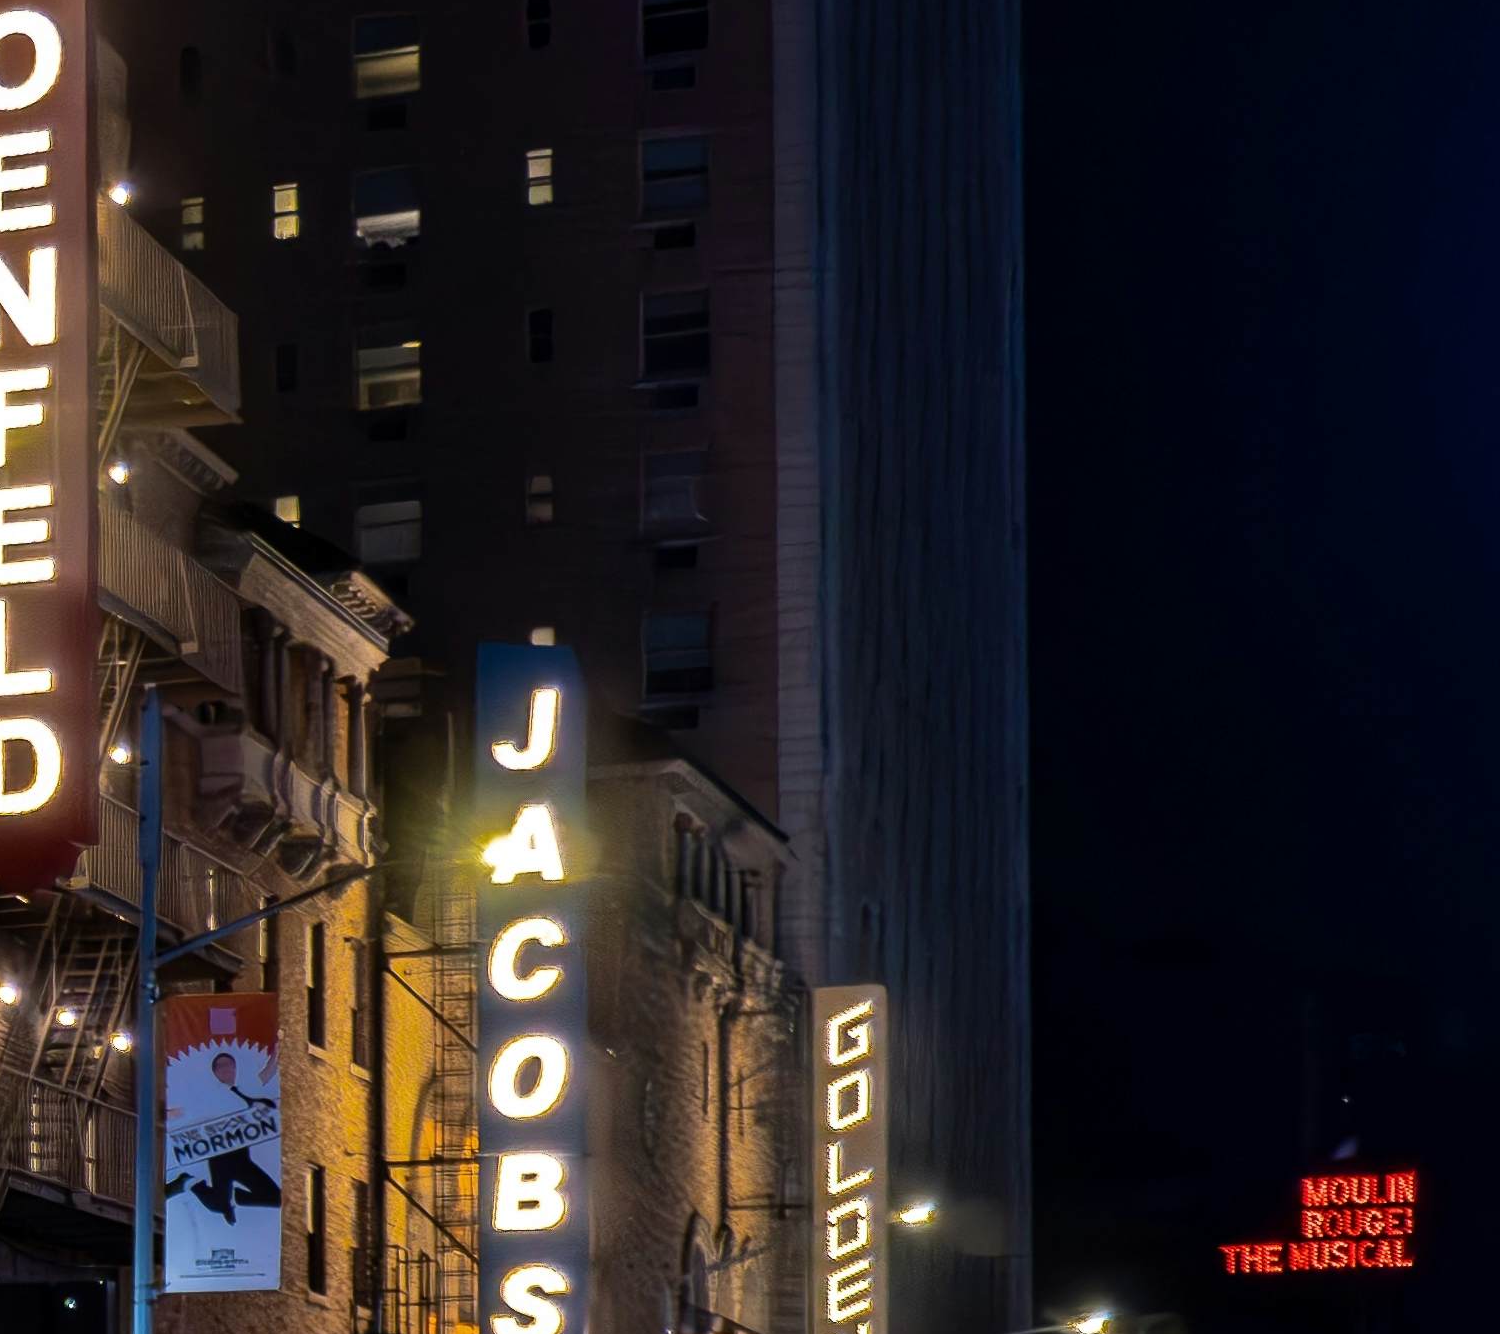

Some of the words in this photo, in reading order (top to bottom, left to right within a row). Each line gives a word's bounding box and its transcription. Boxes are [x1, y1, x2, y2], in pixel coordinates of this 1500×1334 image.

[173, 1116, 278, 1164] MORMON
[1301, 1170, 1414, 1207] MOULIN
[1217, 1242, 1283, 1275] THE
[1288, 1238, 1413, 1271] MUSICAL
